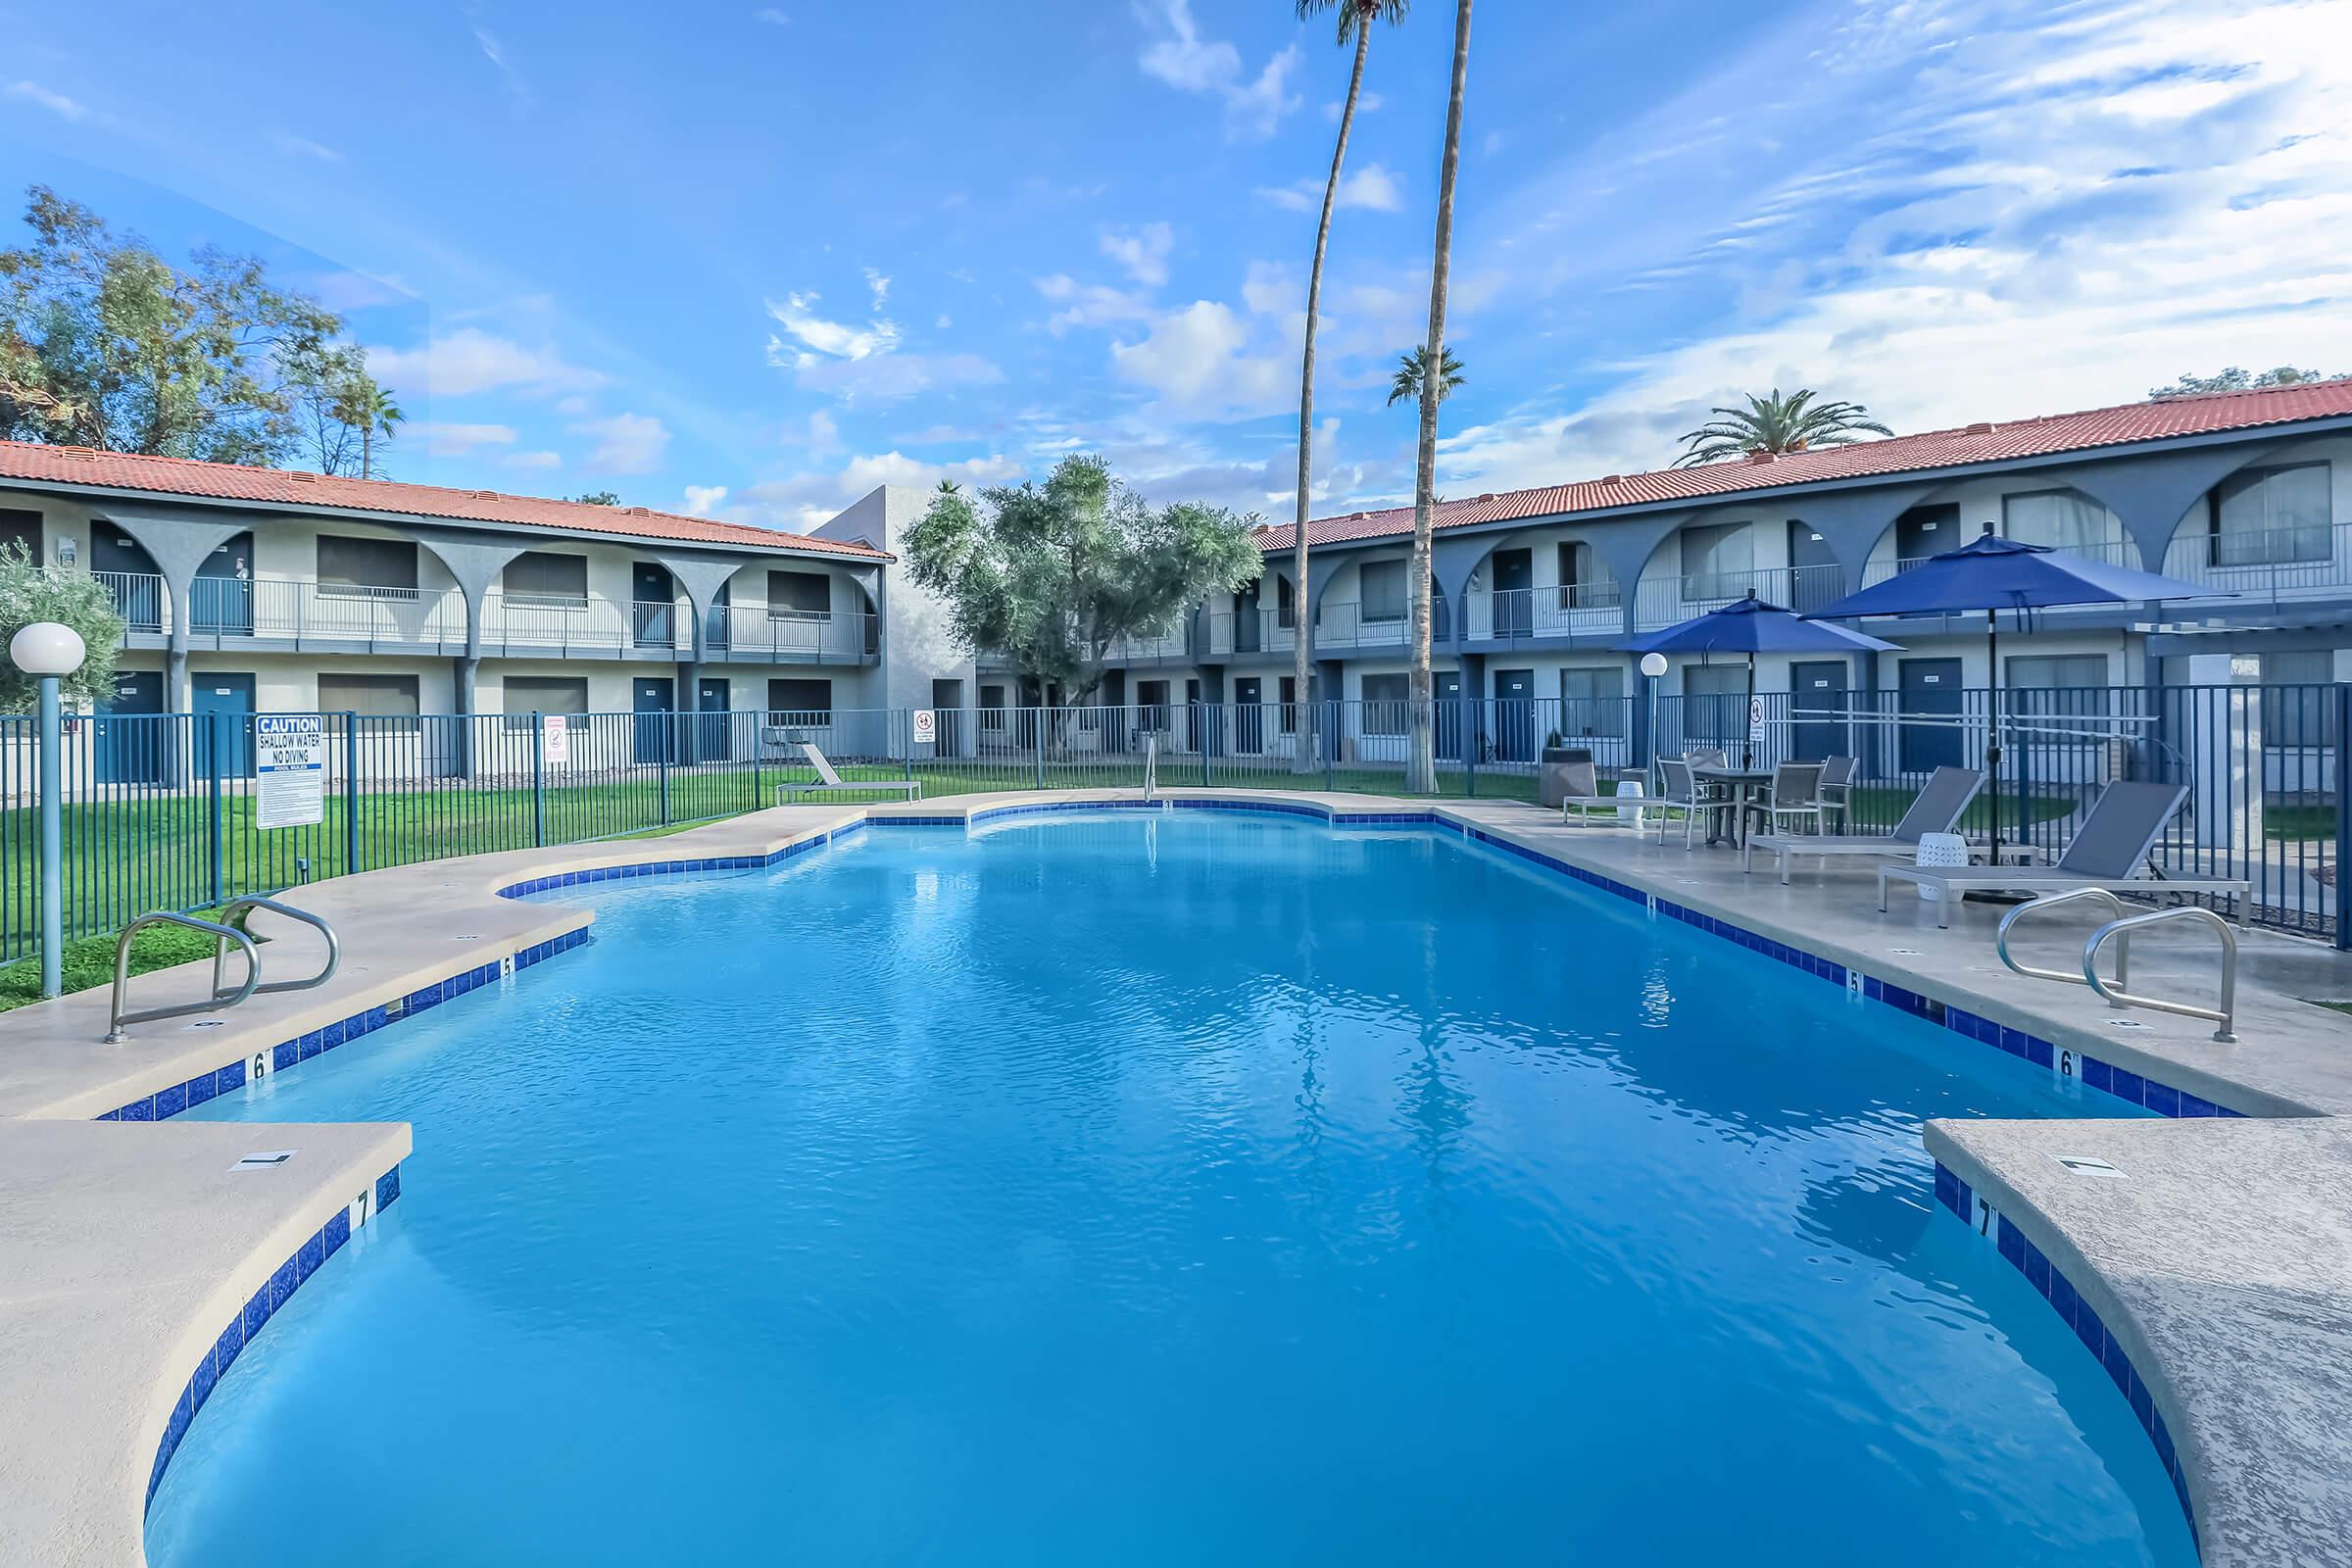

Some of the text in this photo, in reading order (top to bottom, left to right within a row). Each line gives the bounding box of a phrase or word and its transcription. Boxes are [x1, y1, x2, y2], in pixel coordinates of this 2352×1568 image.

[260, 718, 319, 733] CAUTION
[260, 733, 320, 749] SHALLOW WATER
[273, 750, 309, 763] NO DIVING
[505, 956, 511, 976] 5
[1851, 971, 1858, 991] 5
[255, 1053, 265, 1079] 6
[2061, 1050, 2072, 1076] 6
[358, 1190, 368, 1228] 7
[1979, 1197, 1990, 1237] 7
